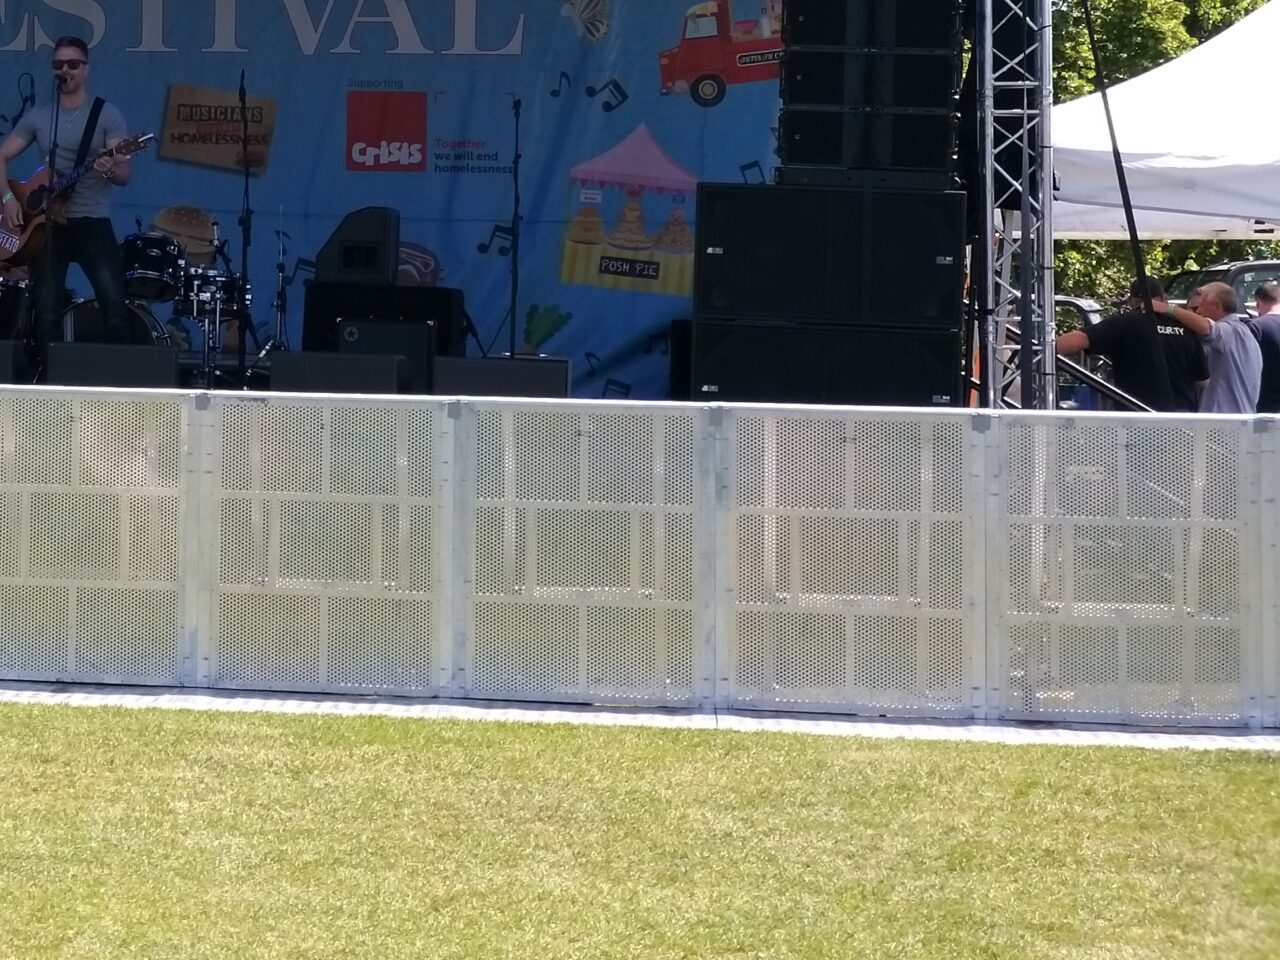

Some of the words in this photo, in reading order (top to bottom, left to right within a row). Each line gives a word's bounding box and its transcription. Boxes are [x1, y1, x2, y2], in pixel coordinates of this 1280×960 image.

[346, 78, 404, 89] Supporting
[434, 139, 487, 150] Together
[434, 153, 452, 161] we
[453, 152, 474, 161] will
[476, 152, 498, 161] end
[434, 163, 514, 174] homelessness
[601, 259, 630, 273] POSH
[635, 263, 658, 276] PIE
